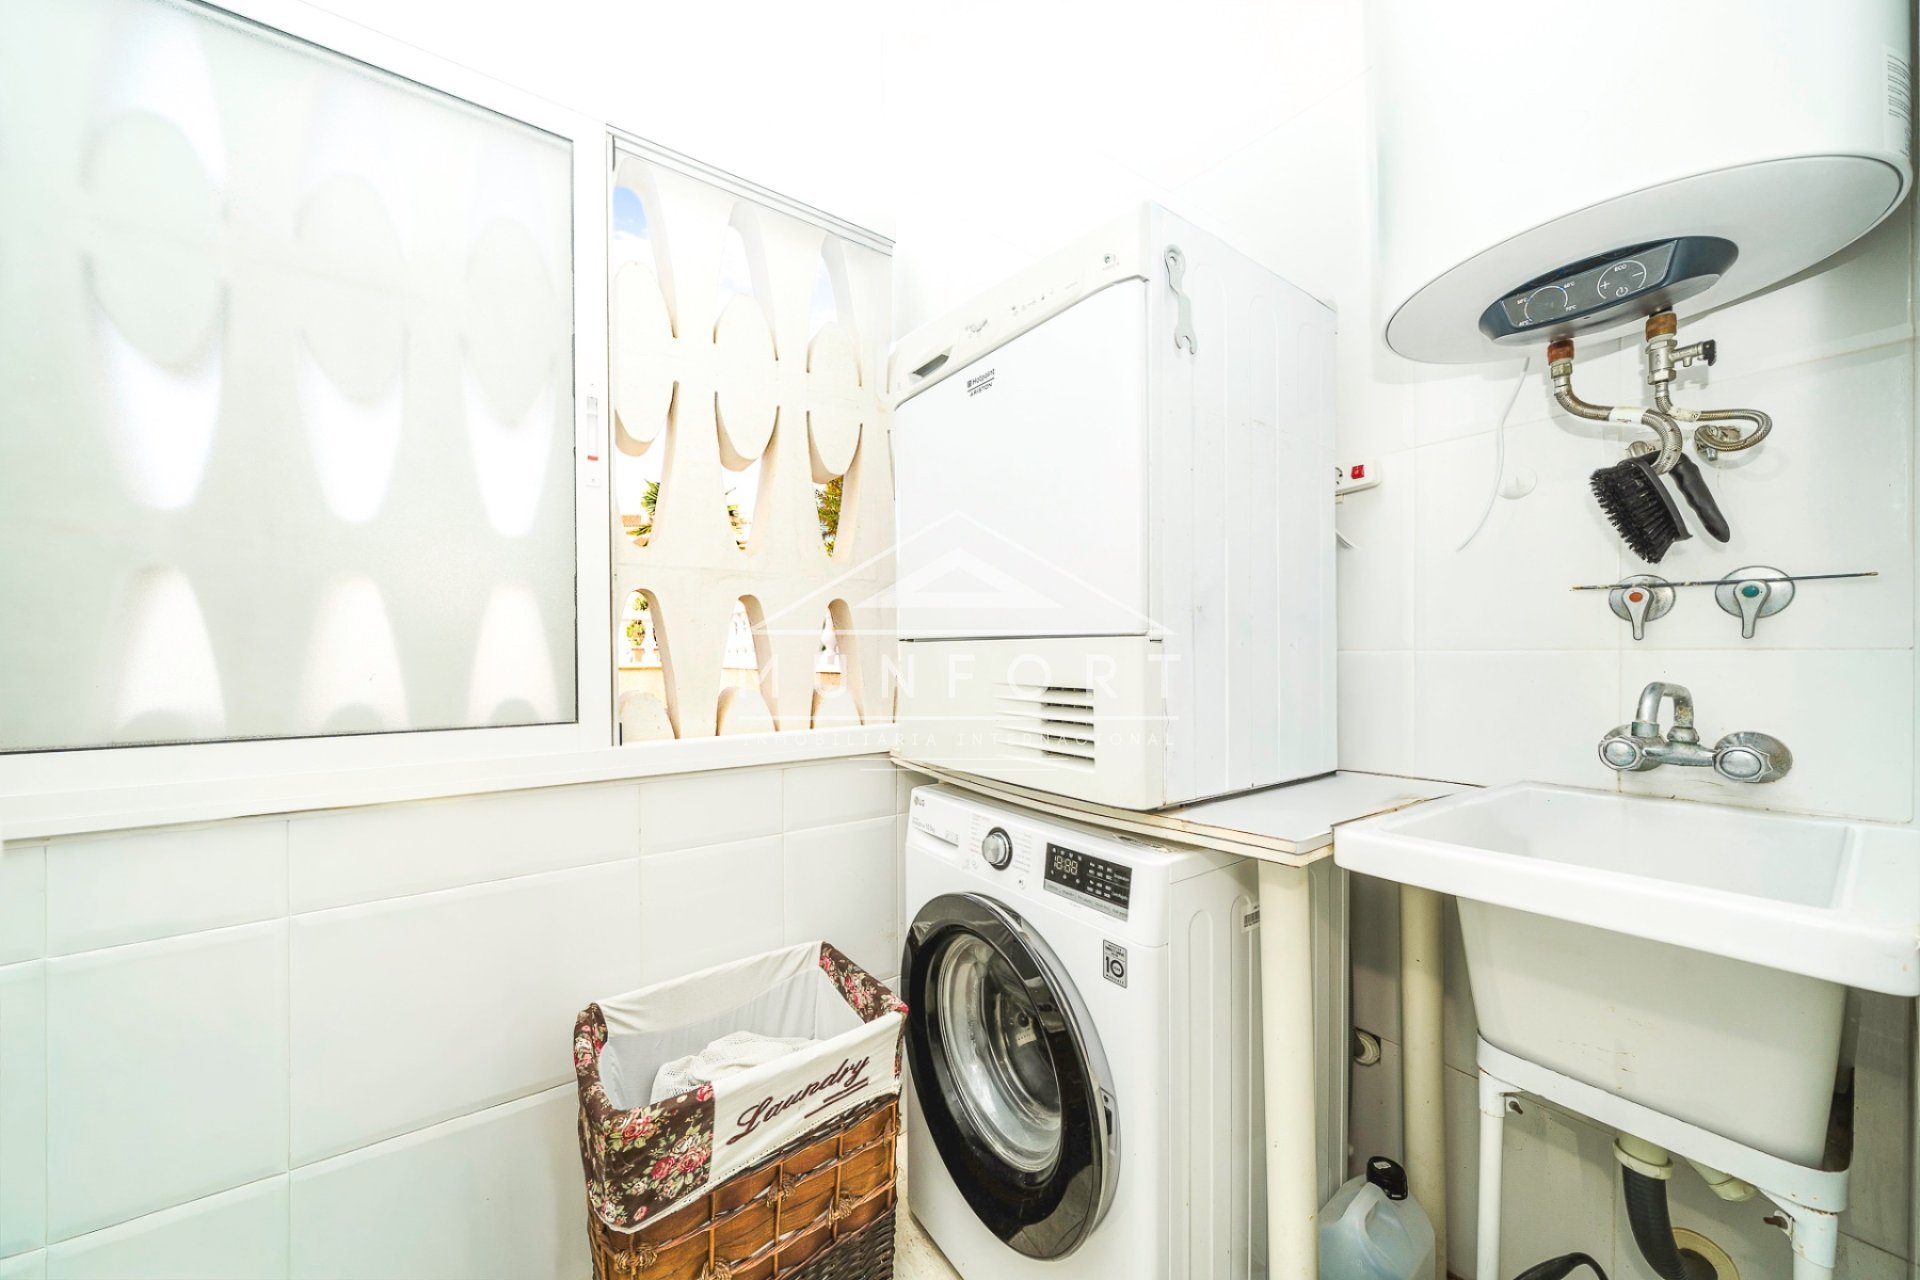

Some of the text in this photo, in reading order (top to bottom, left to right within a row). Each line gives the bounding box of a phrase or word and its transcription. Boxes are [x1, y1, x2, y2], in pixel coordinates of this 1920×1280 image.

[1614, 264, 1627, 272] ECO
[1105, 955, 1125, 979] 10
[725, 1056, 870, 1146] Laundry
